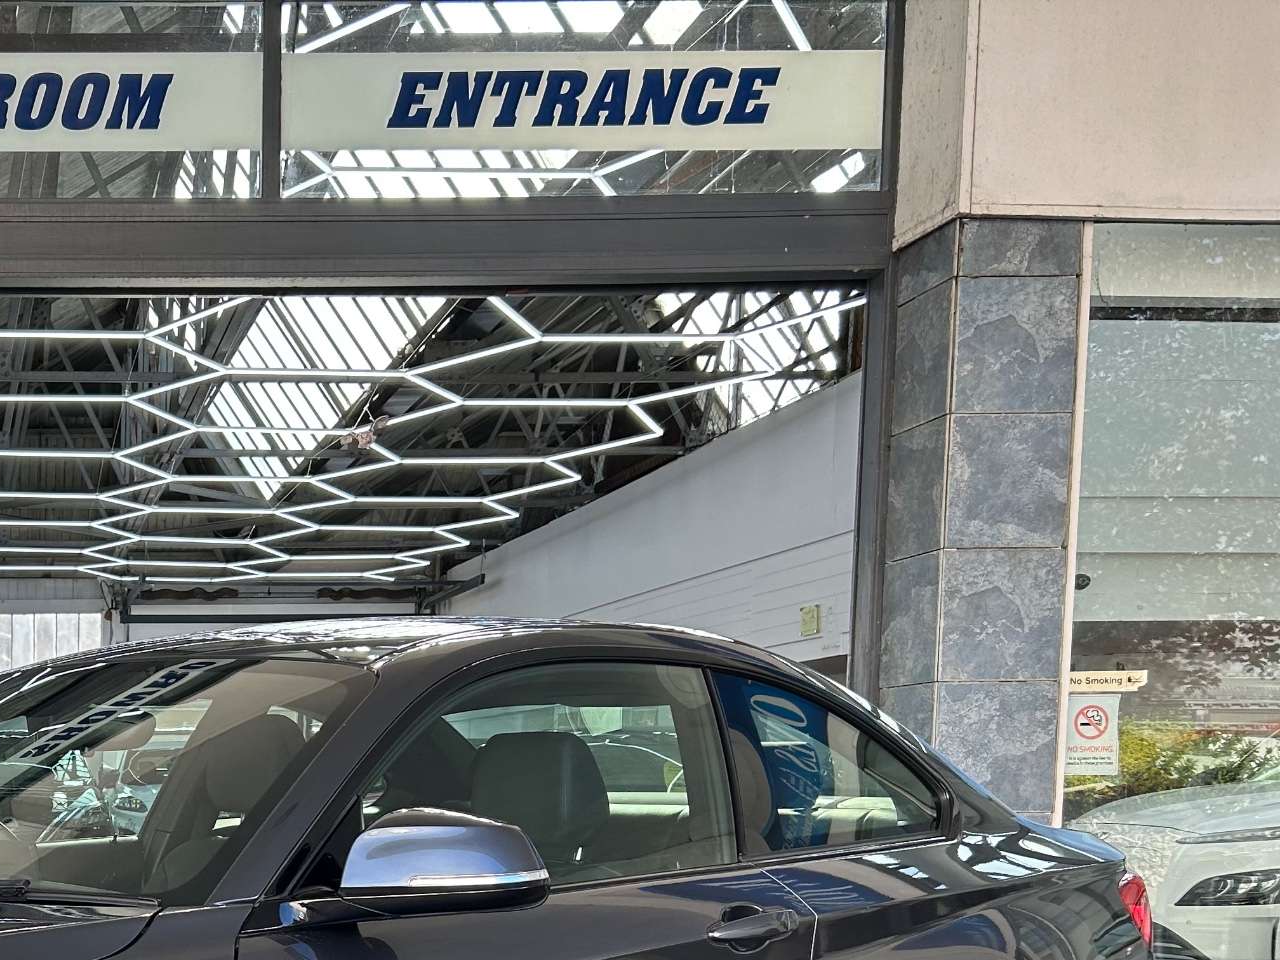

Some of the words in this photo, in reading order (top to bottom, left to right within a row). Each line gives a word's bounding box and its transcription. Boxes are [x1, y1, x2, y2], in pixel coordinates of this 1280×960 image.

[386, 66, 782, 130] ENTRANCE
[1085, 677, 1123, 686] Smoking
[1079, 745, 1114, 753] SMOKING
